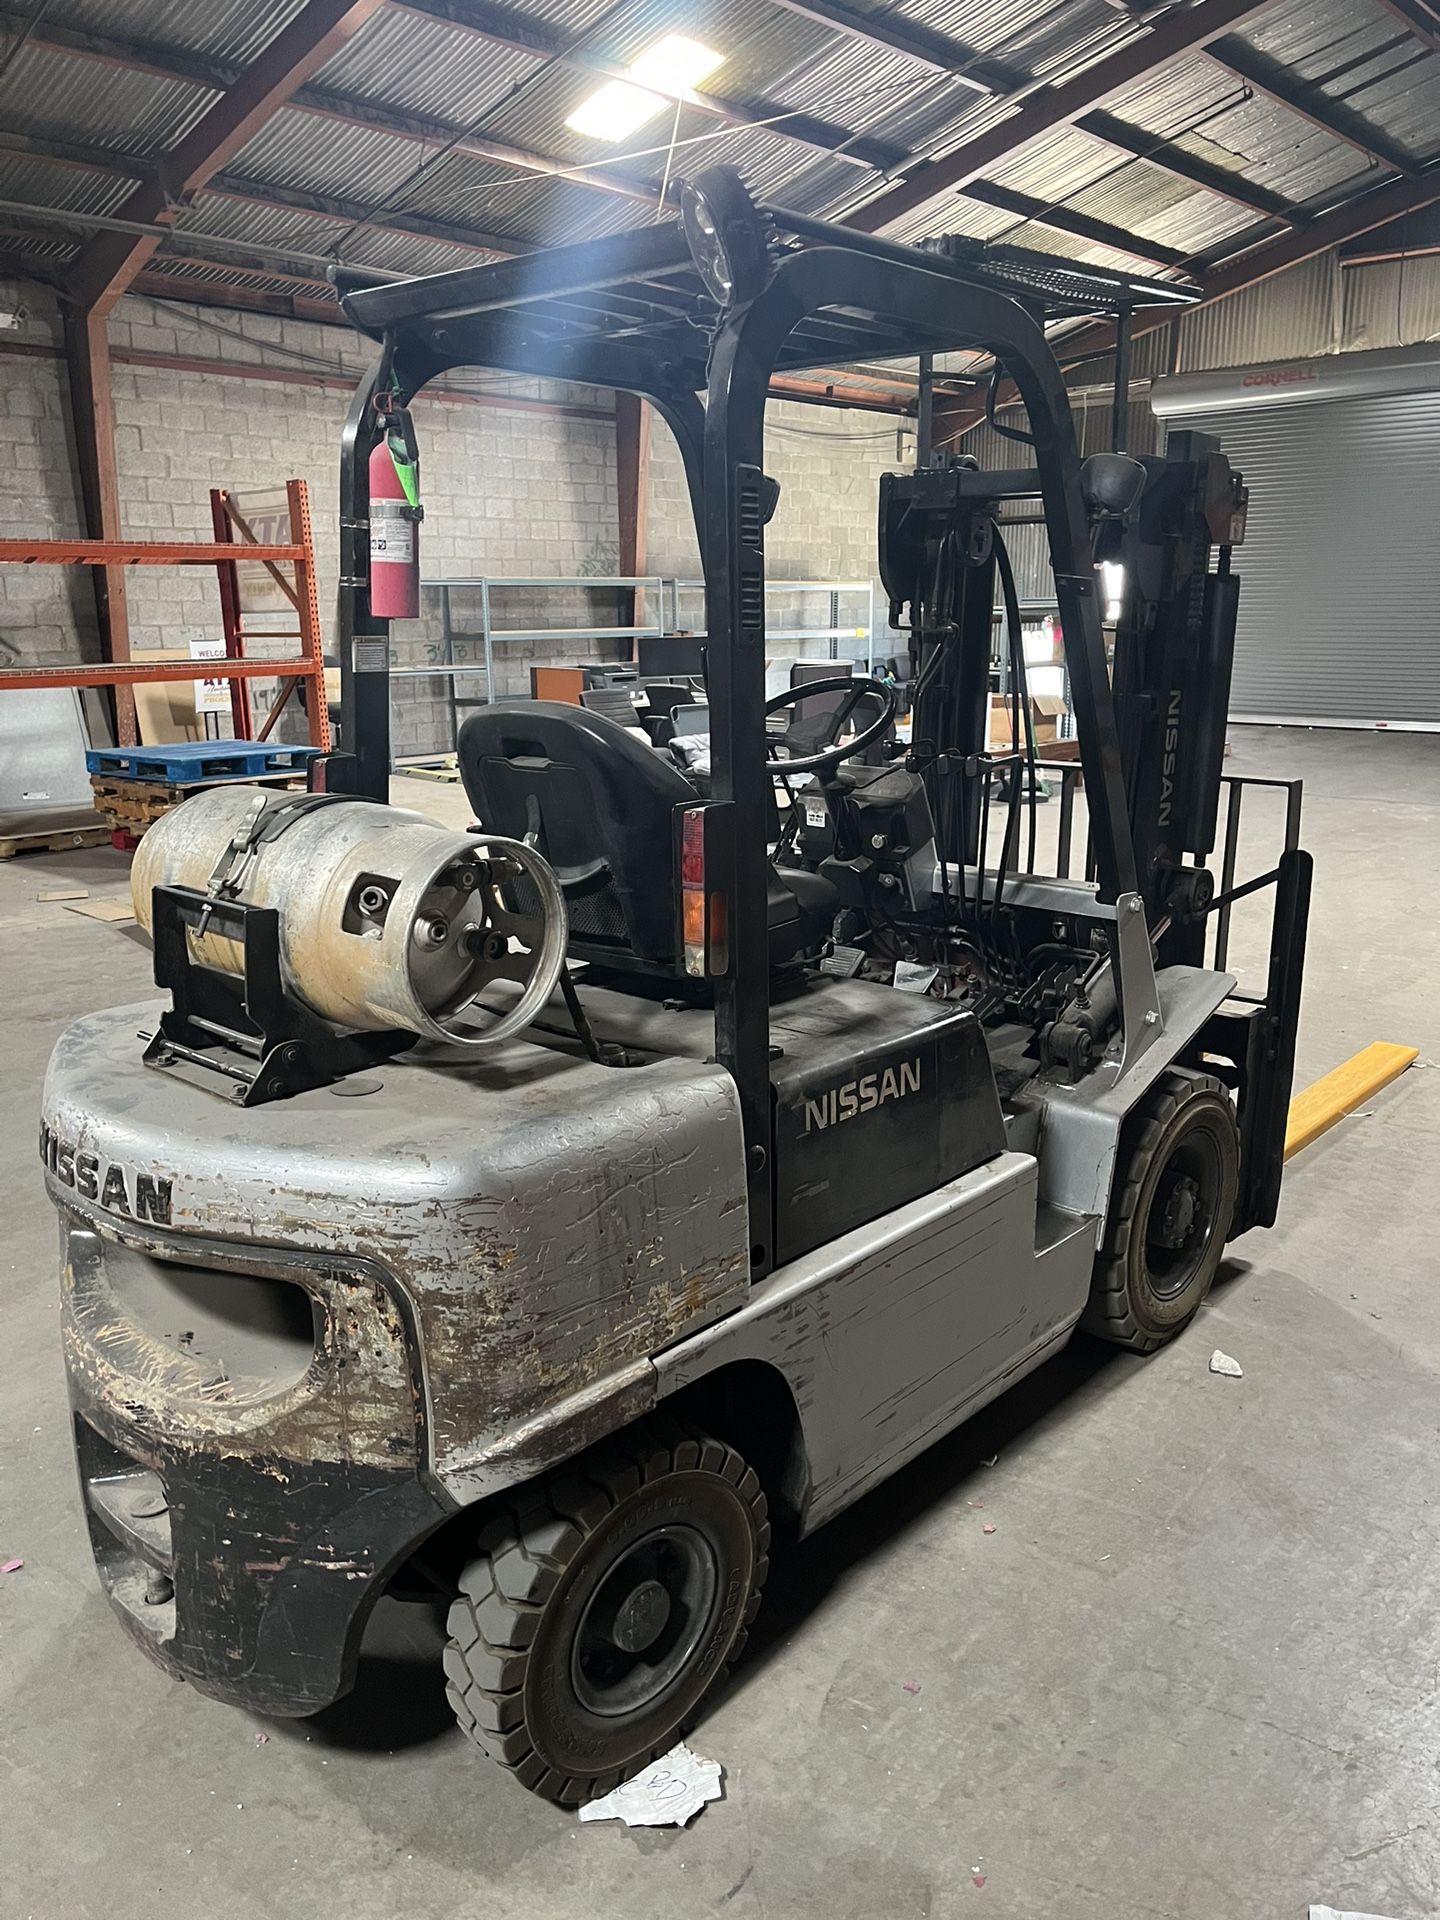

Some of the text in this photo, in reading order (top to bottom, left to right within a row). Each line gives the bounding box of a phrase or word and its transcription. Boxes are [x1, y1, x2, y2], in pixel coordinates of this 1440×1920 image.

[1242, 366, 1318, 388] CORNELL
[198, 649, 225, 658] WELCO
[1157, 689, 1182, 827] NISSAN
[805, 1057, 921, 1131] NISSAN
